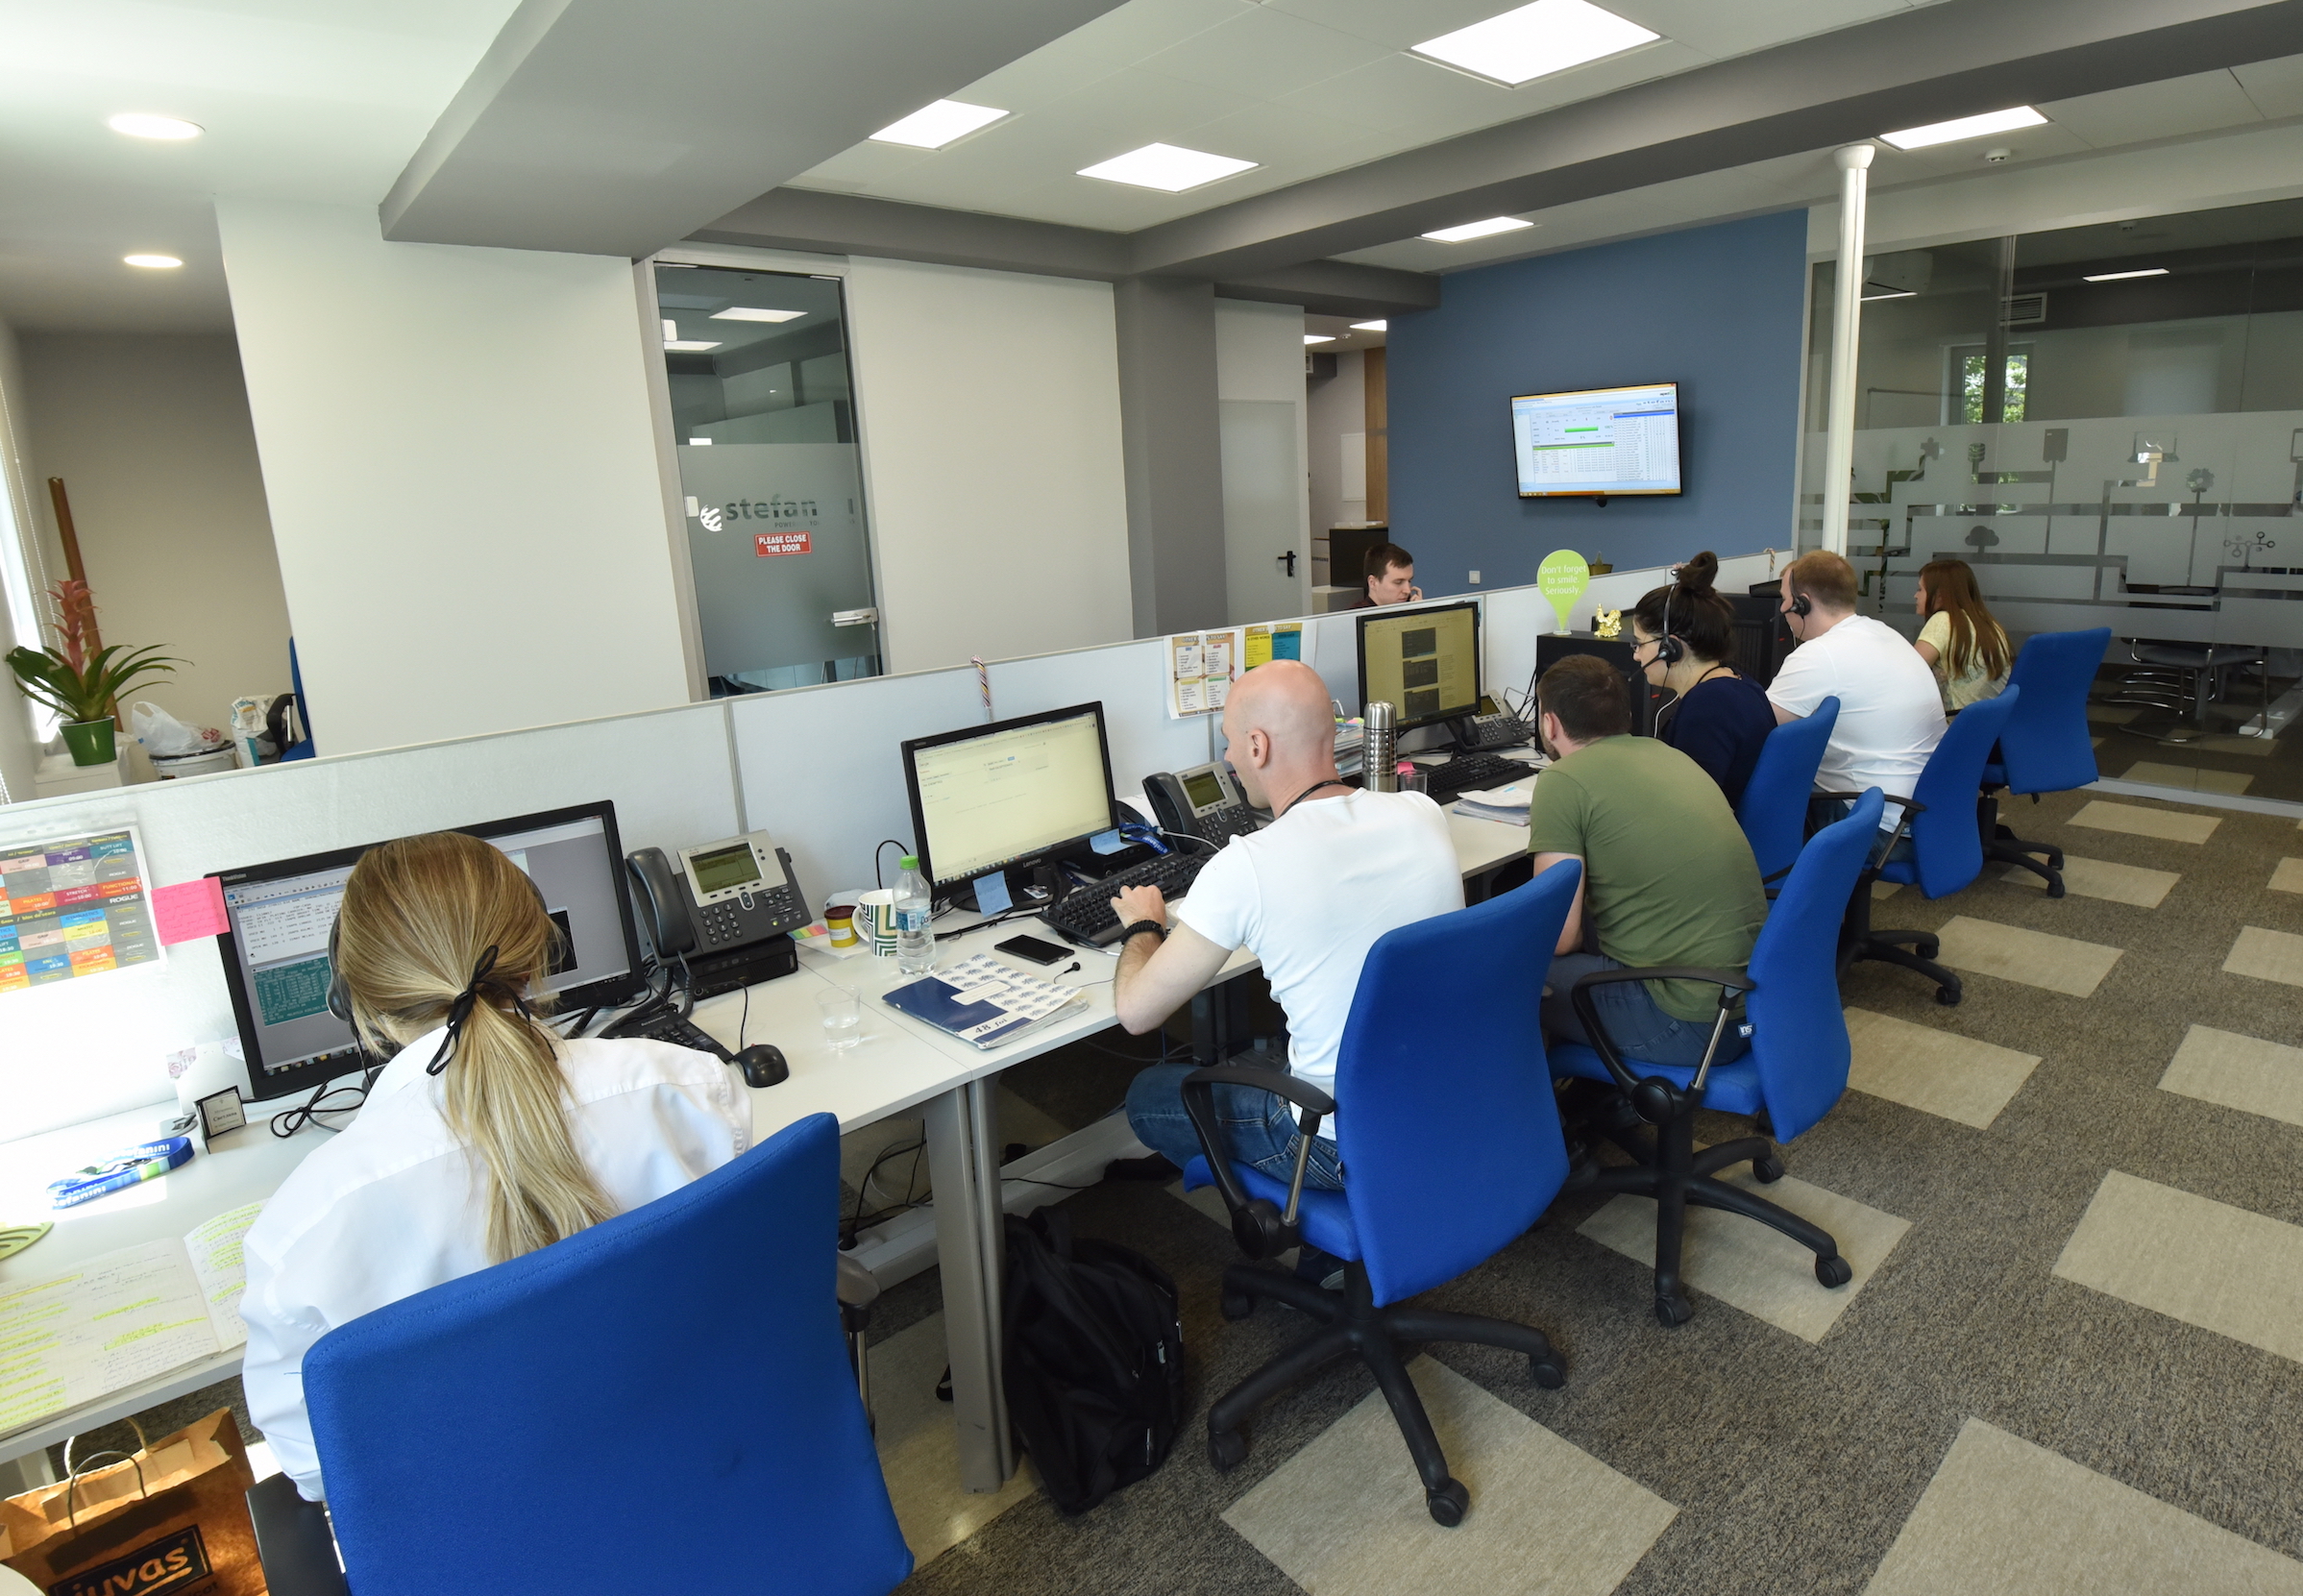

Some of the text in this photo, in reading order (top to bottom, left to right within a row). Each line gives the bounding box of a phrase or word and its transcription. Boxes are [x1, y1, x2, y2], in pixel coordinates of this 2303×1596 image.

[758, 534, 807, 546] PLEASE CLOSE
[767, 544, 801, 553] THE DOOR
[1541, 565, 1586, 576] Don't forget
[1556, 575, 1580, 584] smile.
[1545, 586, 1581, 596] Seriously.
[1022, 858, 1041, 869] Lenovo
[103, 880, 137, 890] FUNCTIONAL
[110, 894, 138, 904] ROGUE
[975, 1024, 992, 1034] 48
